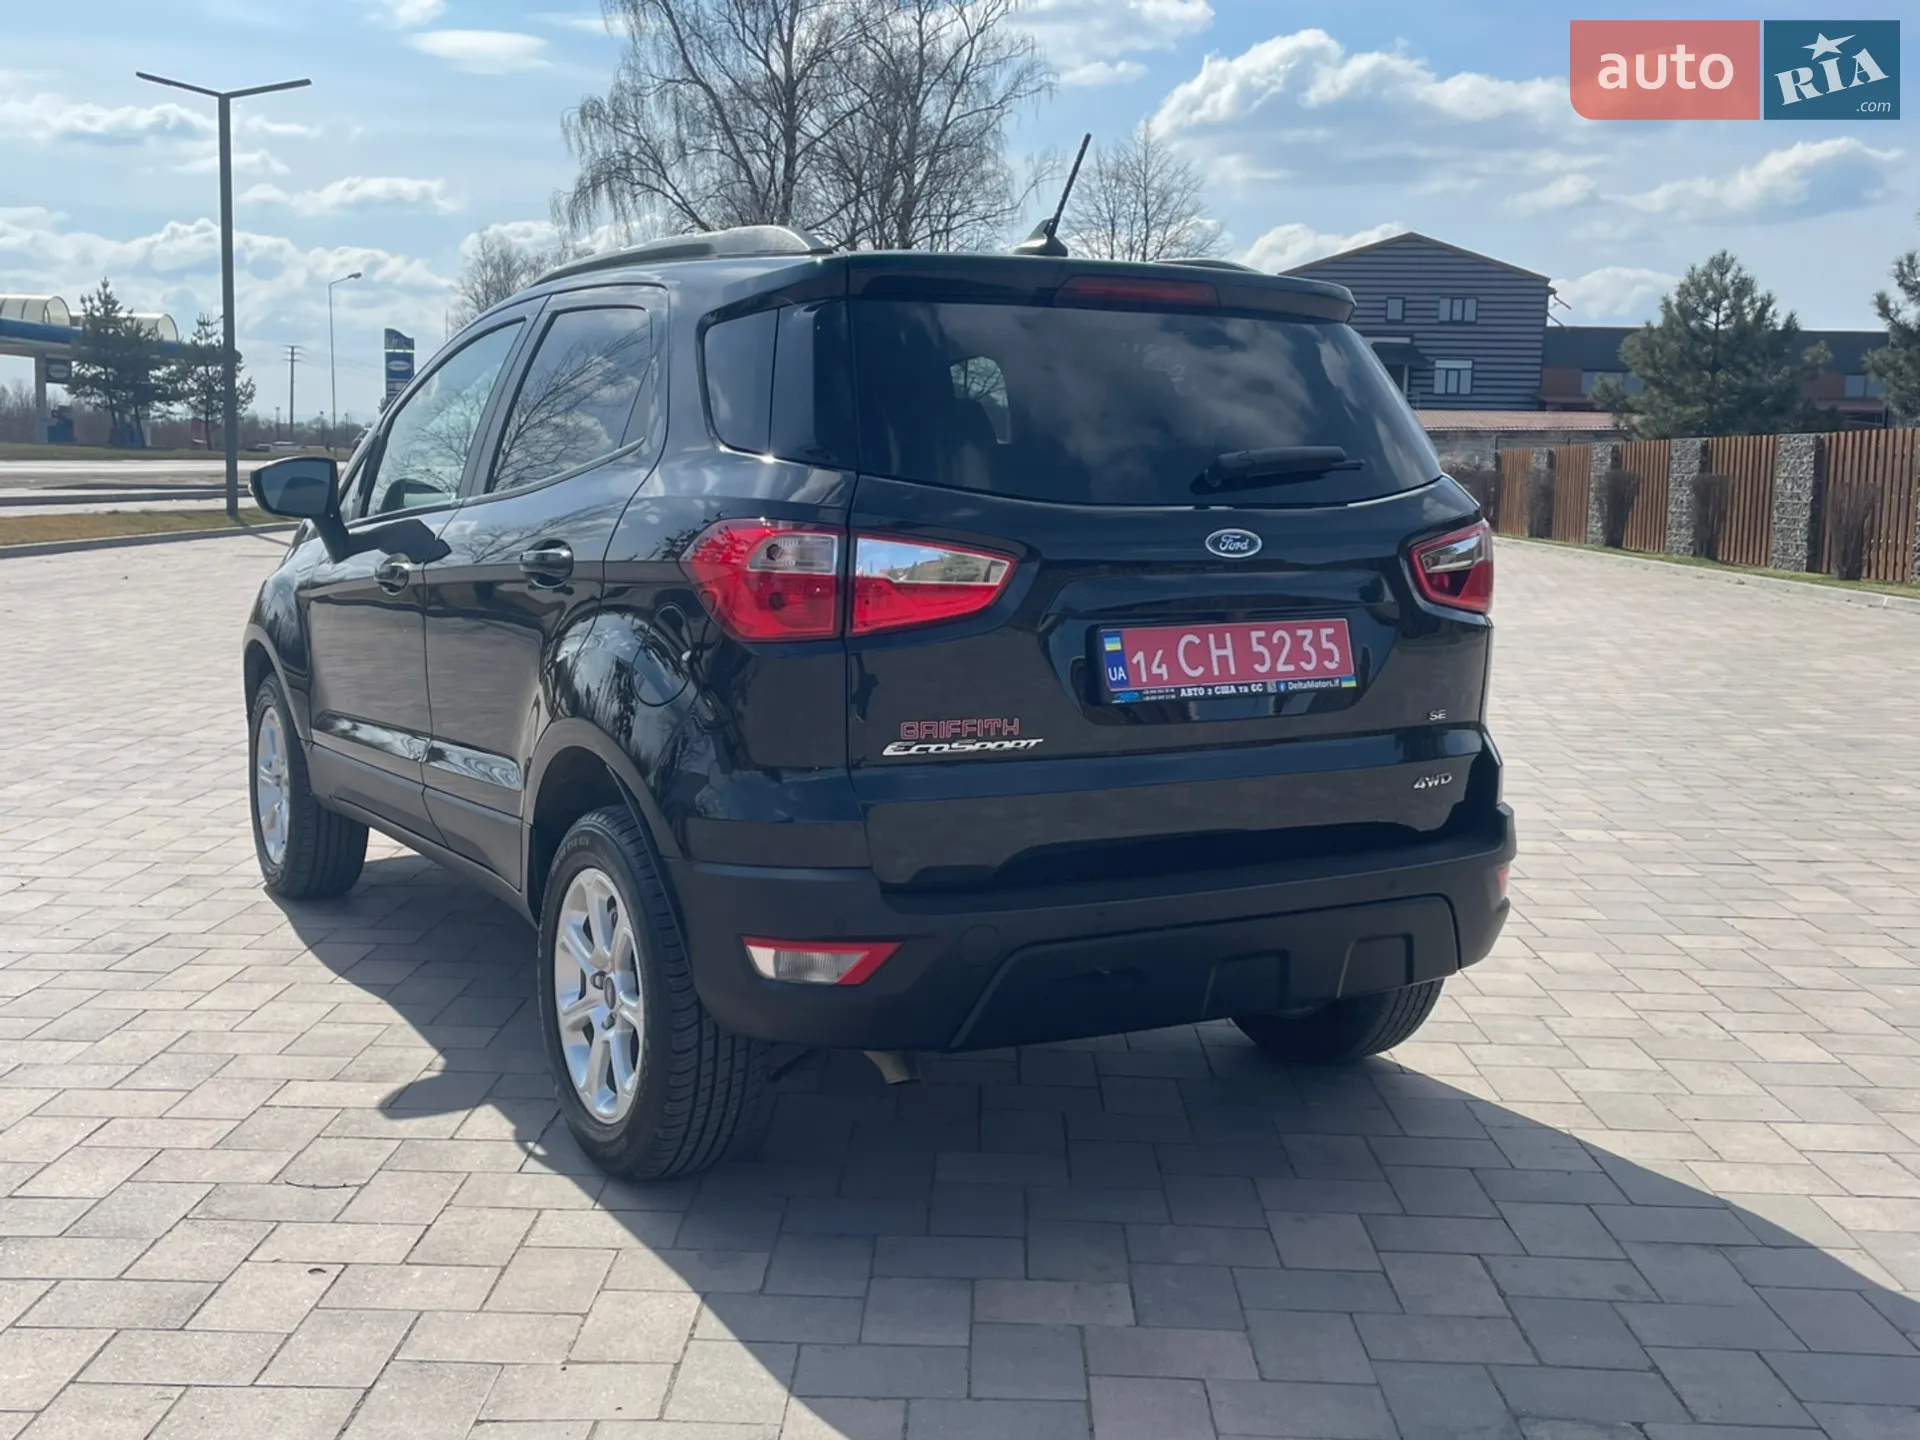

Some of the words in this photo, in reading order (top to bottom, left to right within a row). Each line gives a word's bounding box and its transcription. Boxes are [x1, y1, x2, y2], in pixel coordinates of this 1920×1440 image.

[1219, 534, 1249, 550] Ford
[1131, 649, 1169, 683] 14
[1177, 632, 1237, 678] CH
[1249, 627, 1341, 673] 5235
[1108, 666, 1127, 682] UA
[1429, 709, 1447, 721] SE
[900, 717, 1020, 740] GRIFFITH
[1413, 772, 1453, 789] 4WD
